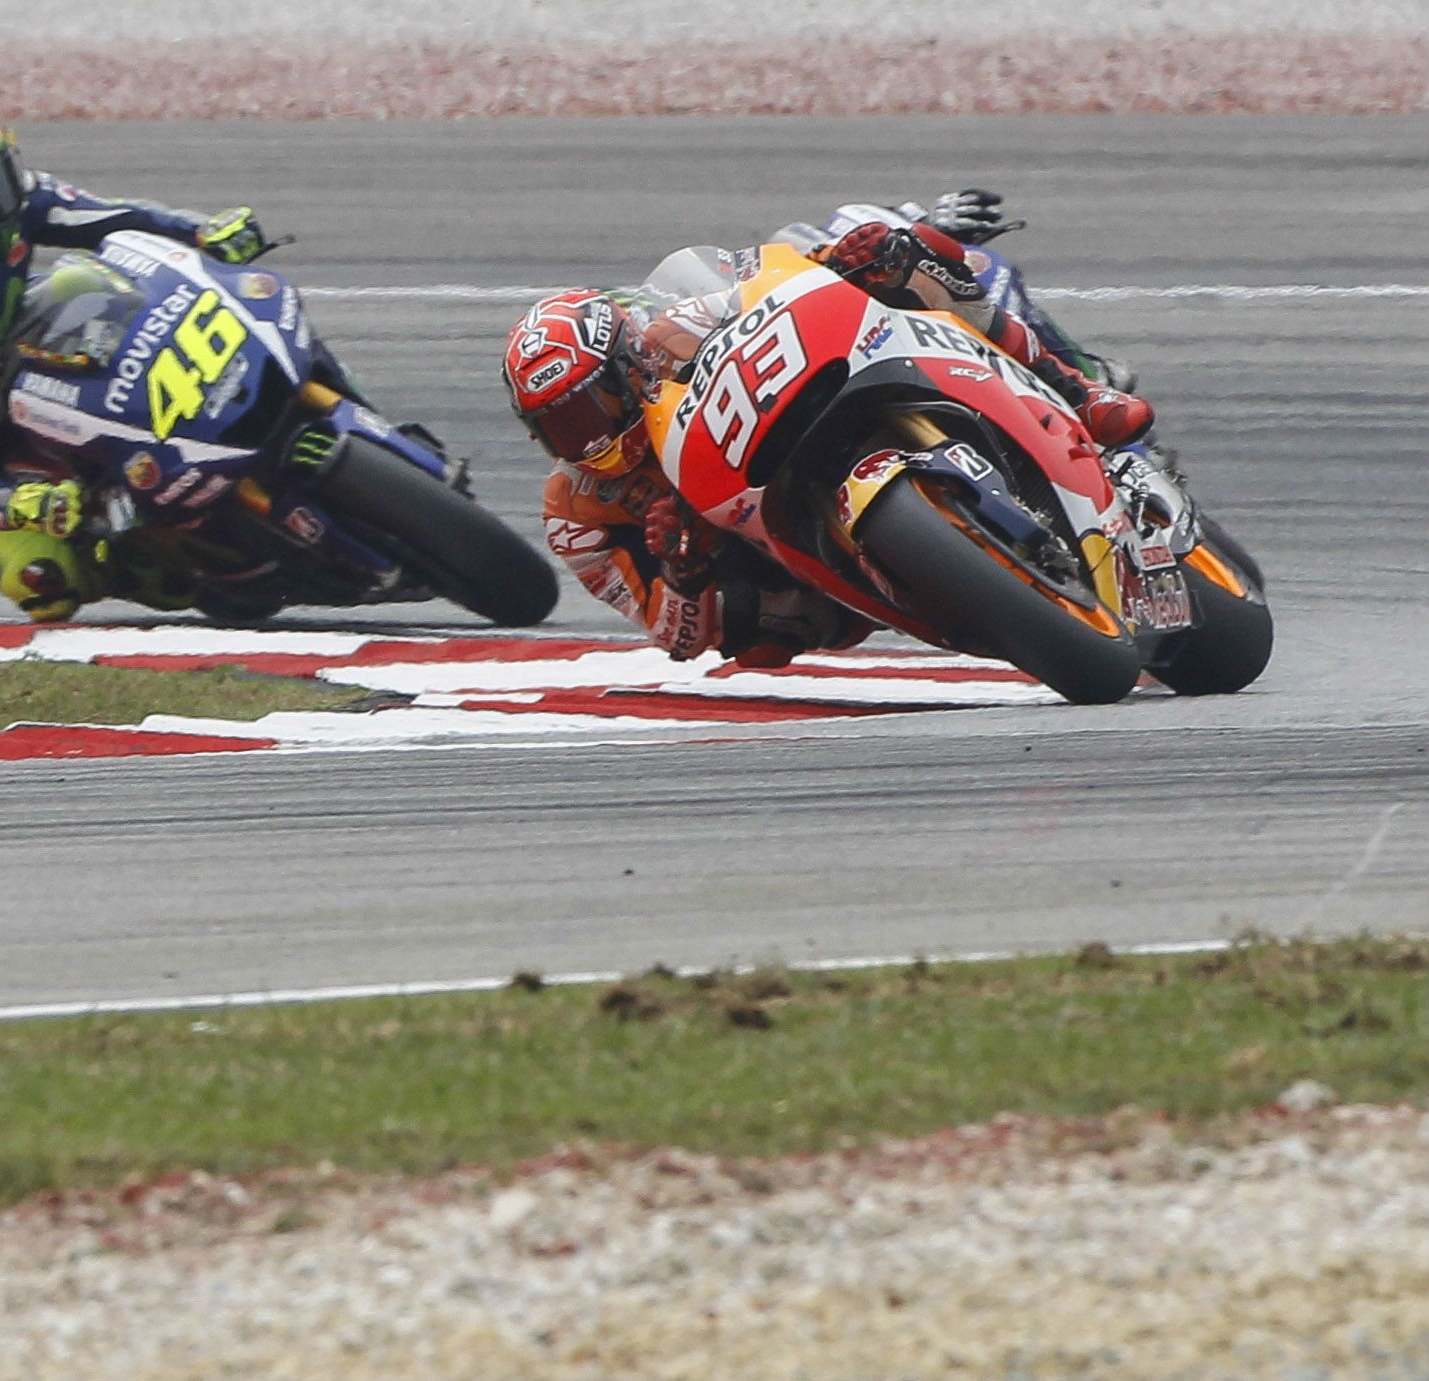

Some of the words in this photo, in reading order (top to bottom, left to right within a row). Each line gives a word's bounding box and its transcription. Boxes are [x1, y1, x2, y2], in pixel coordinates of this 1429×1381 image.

[104, 283, 199, 413] movistar
[147, 288, 249, 442] 46
[531, 361, 565, 390] SHOEI
[593, 303, 613, 352] LOTUS
[675, 295, 786, 431] REPSOL
[702, 308, 809, 470] 93
